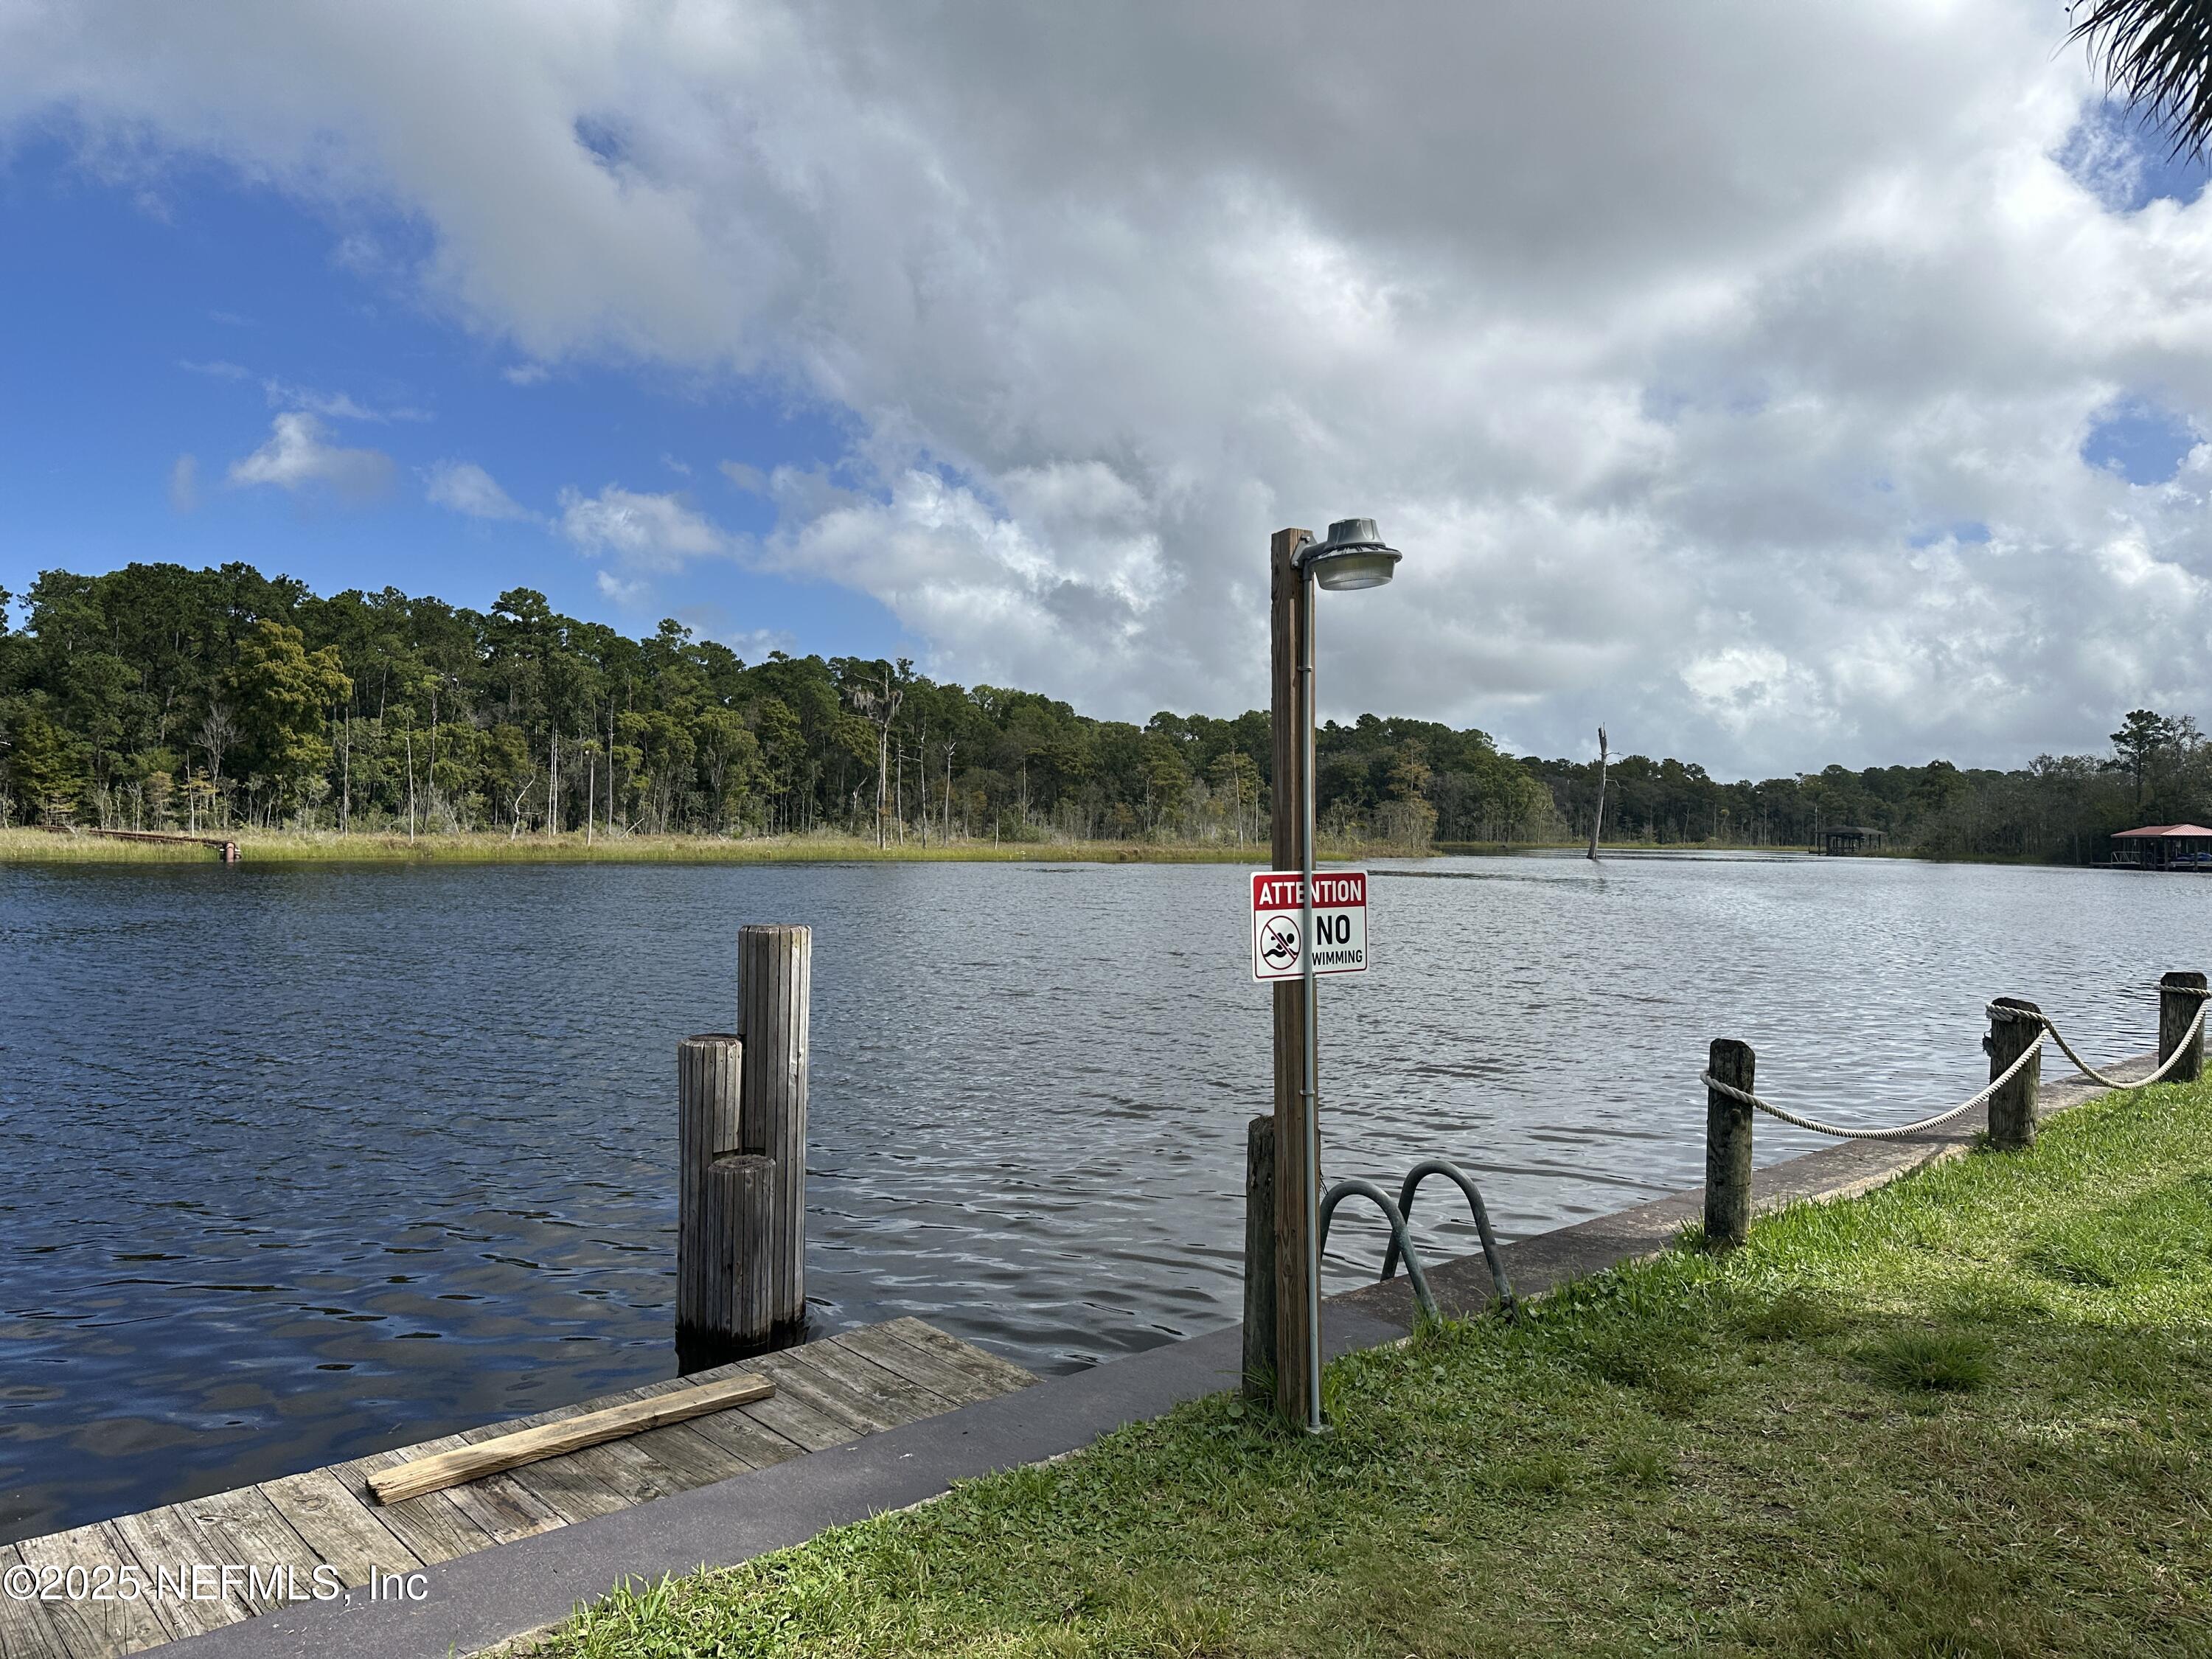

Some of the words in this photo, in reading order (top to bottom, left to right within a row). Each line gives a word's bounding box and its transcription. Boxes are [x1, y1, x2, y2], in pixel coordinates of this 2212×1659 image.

[1259, 880, 1362, 905] ATTENTION
[1316, 914, 1350, 945] NO
[1311, 950, 1363, 966] WIMMING
